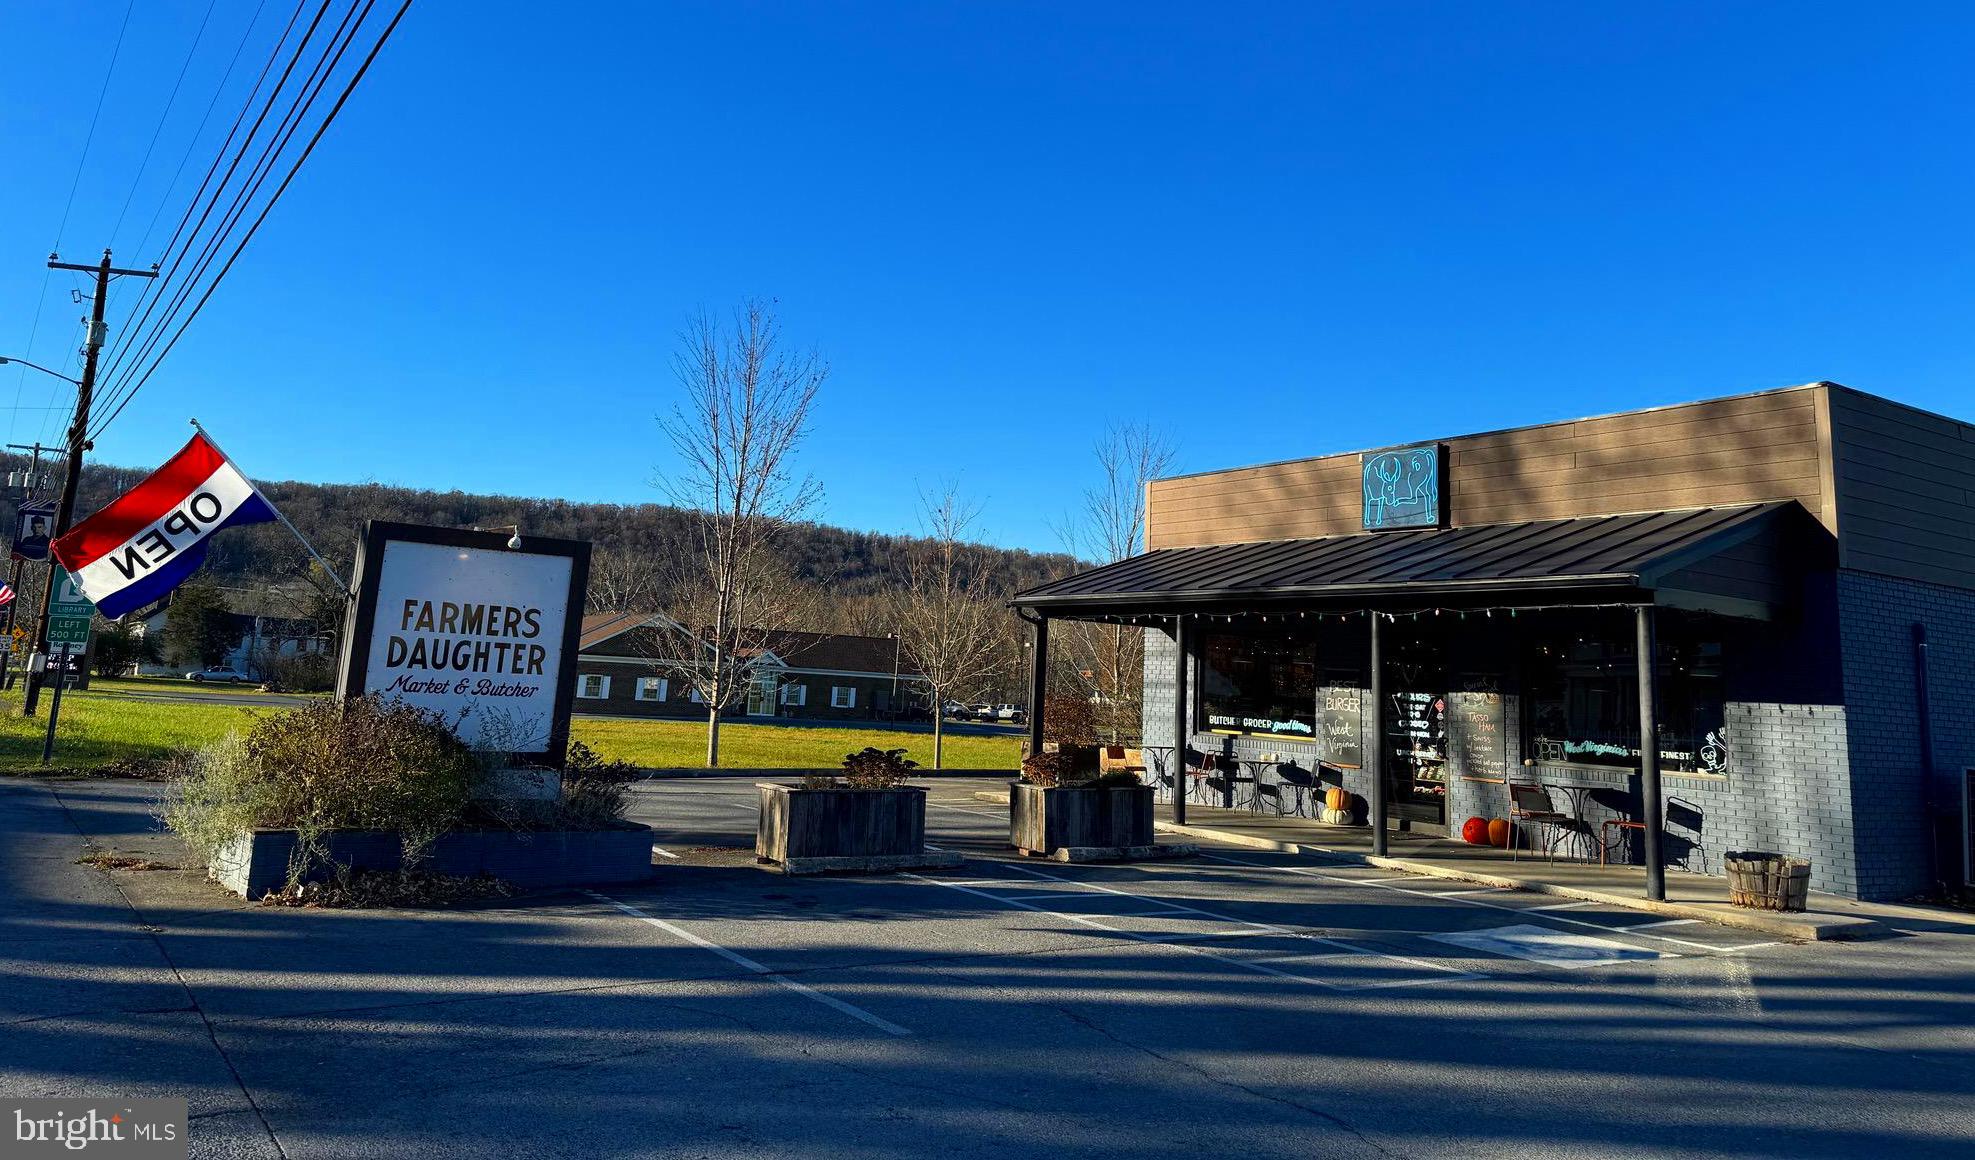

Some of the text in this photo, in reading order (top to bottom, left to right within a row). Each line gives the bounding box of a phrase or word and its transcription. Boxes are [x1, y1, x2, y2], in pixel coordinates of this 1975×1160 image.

[57, 606, 87, 614] LIBRARY
[58, 620, 81, 629] LEFT
[50, 630, 85, 639] 500 FT
[386, 635, 546, 675] DAUGHTER
[385, 674, 539, 698] Market & Butcher
[1326, 697, 1361, 714] BURGER
[1243, 717, 1272, 729] GROCER
[1466, 711, 1489, 723] TASSO
[1326, 719, 1354, 737] West
[1327, 736, 1359, 756] Virginia
[1532, 741, 1568, 761] OPEN
[1660, 750, 1691, 761] FINEST
